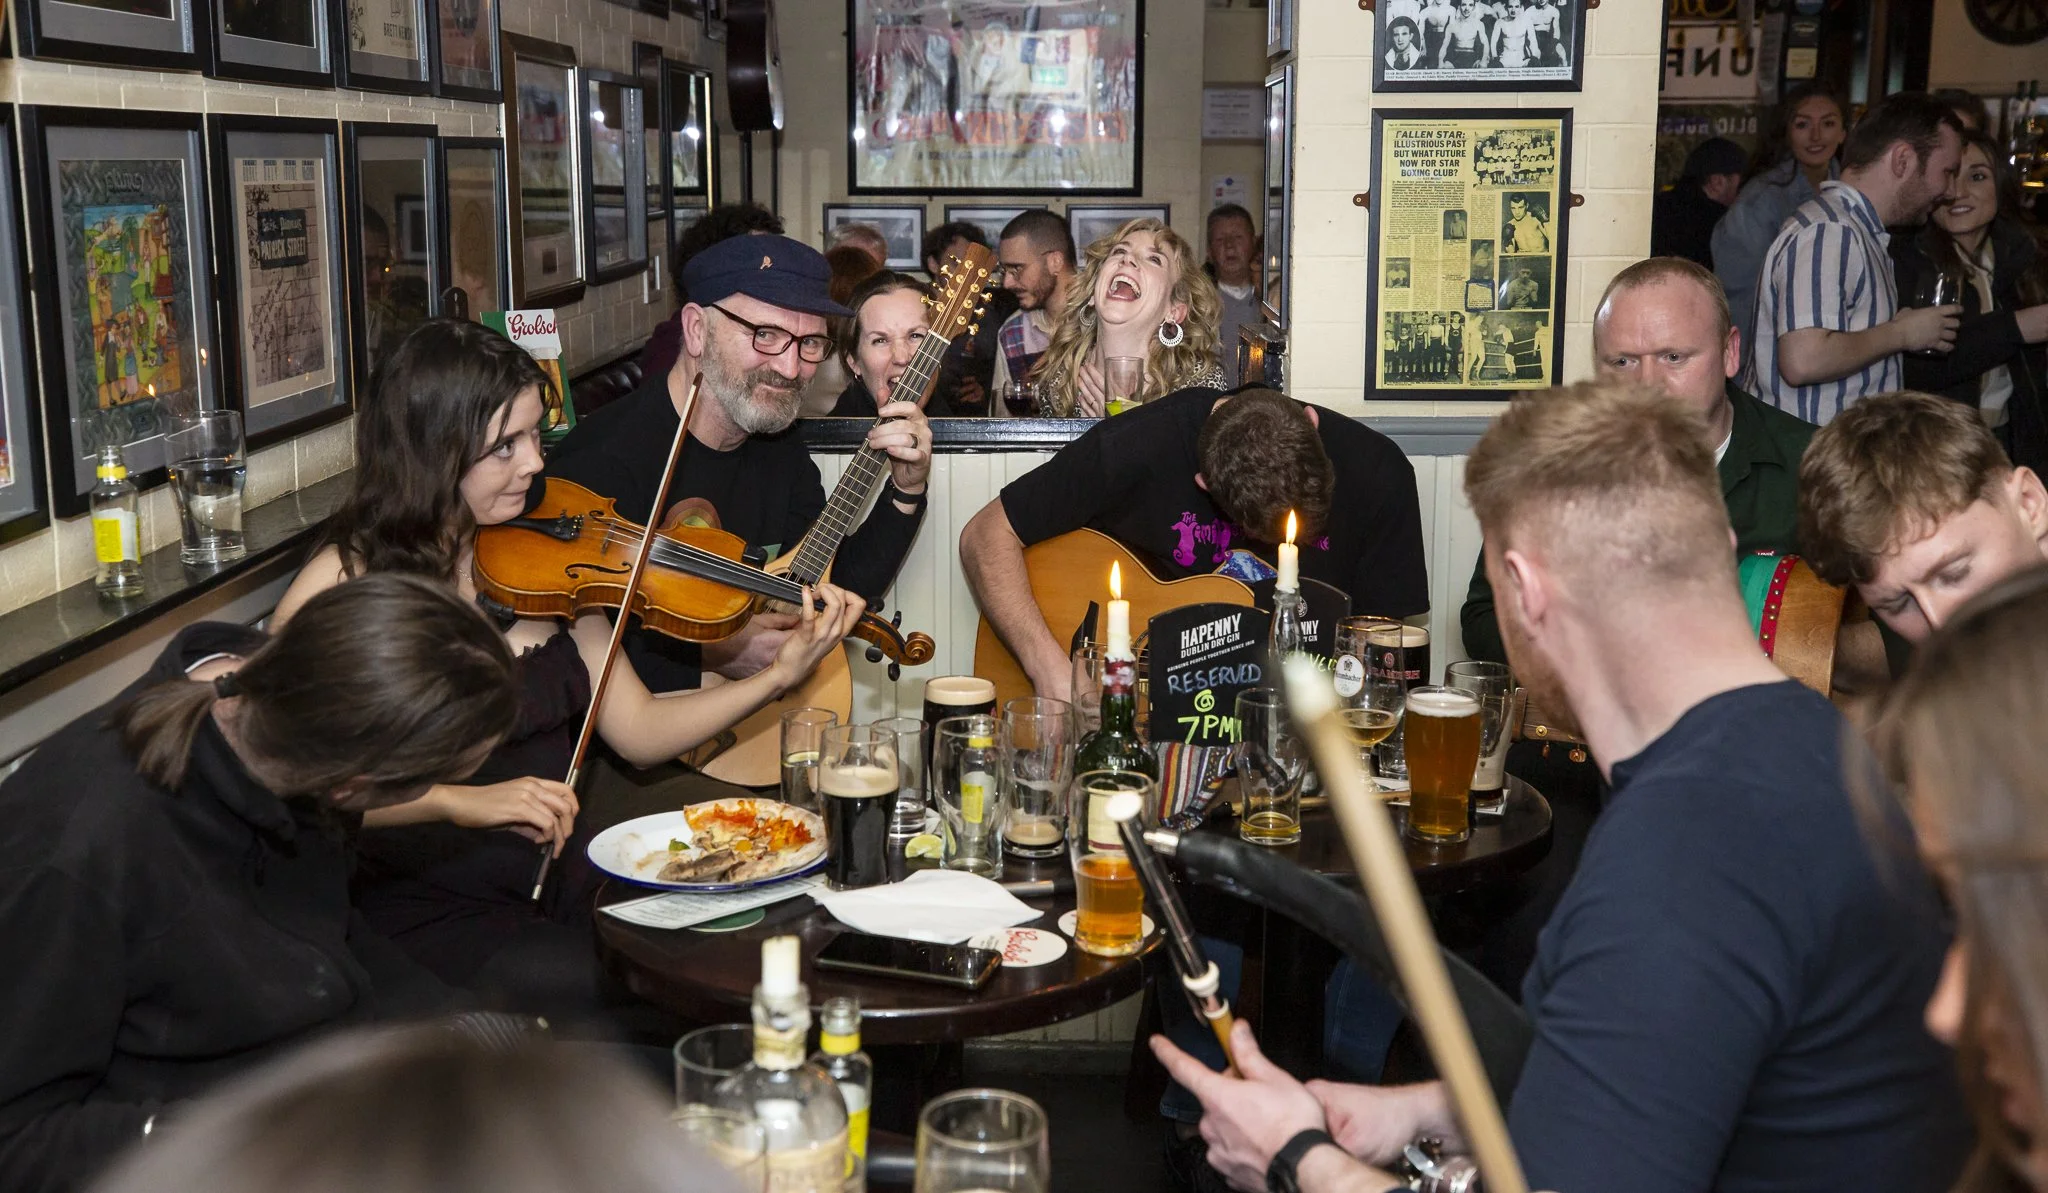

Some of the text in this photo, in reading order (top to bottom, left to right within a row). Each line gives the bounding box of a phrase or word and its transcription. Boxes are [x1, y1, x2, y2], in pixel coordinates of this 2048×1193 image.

[1395, 130, 1466, 139] FALLEN STAR:
[1394, 140, 1466, 148] ILLUSTRIOUS PAST
[1393, 150, 1466, 158] BUT WHAT FUTURE
[1399, 160, 1419, 168] NOW
[1421, 160, 1436, 168] FOR
[1401, 169, 1458, 177] BOXING CLUB?
[1181, 511, 1197, 524] THE
[1180, 612, 1242, 650] HA'PENNY
[1180, 632, 1241, 659] DUBLIN DRY GIN
[1166, 662, 1262, 695] RESERVED
[1193, 689, 1215, 713] @
